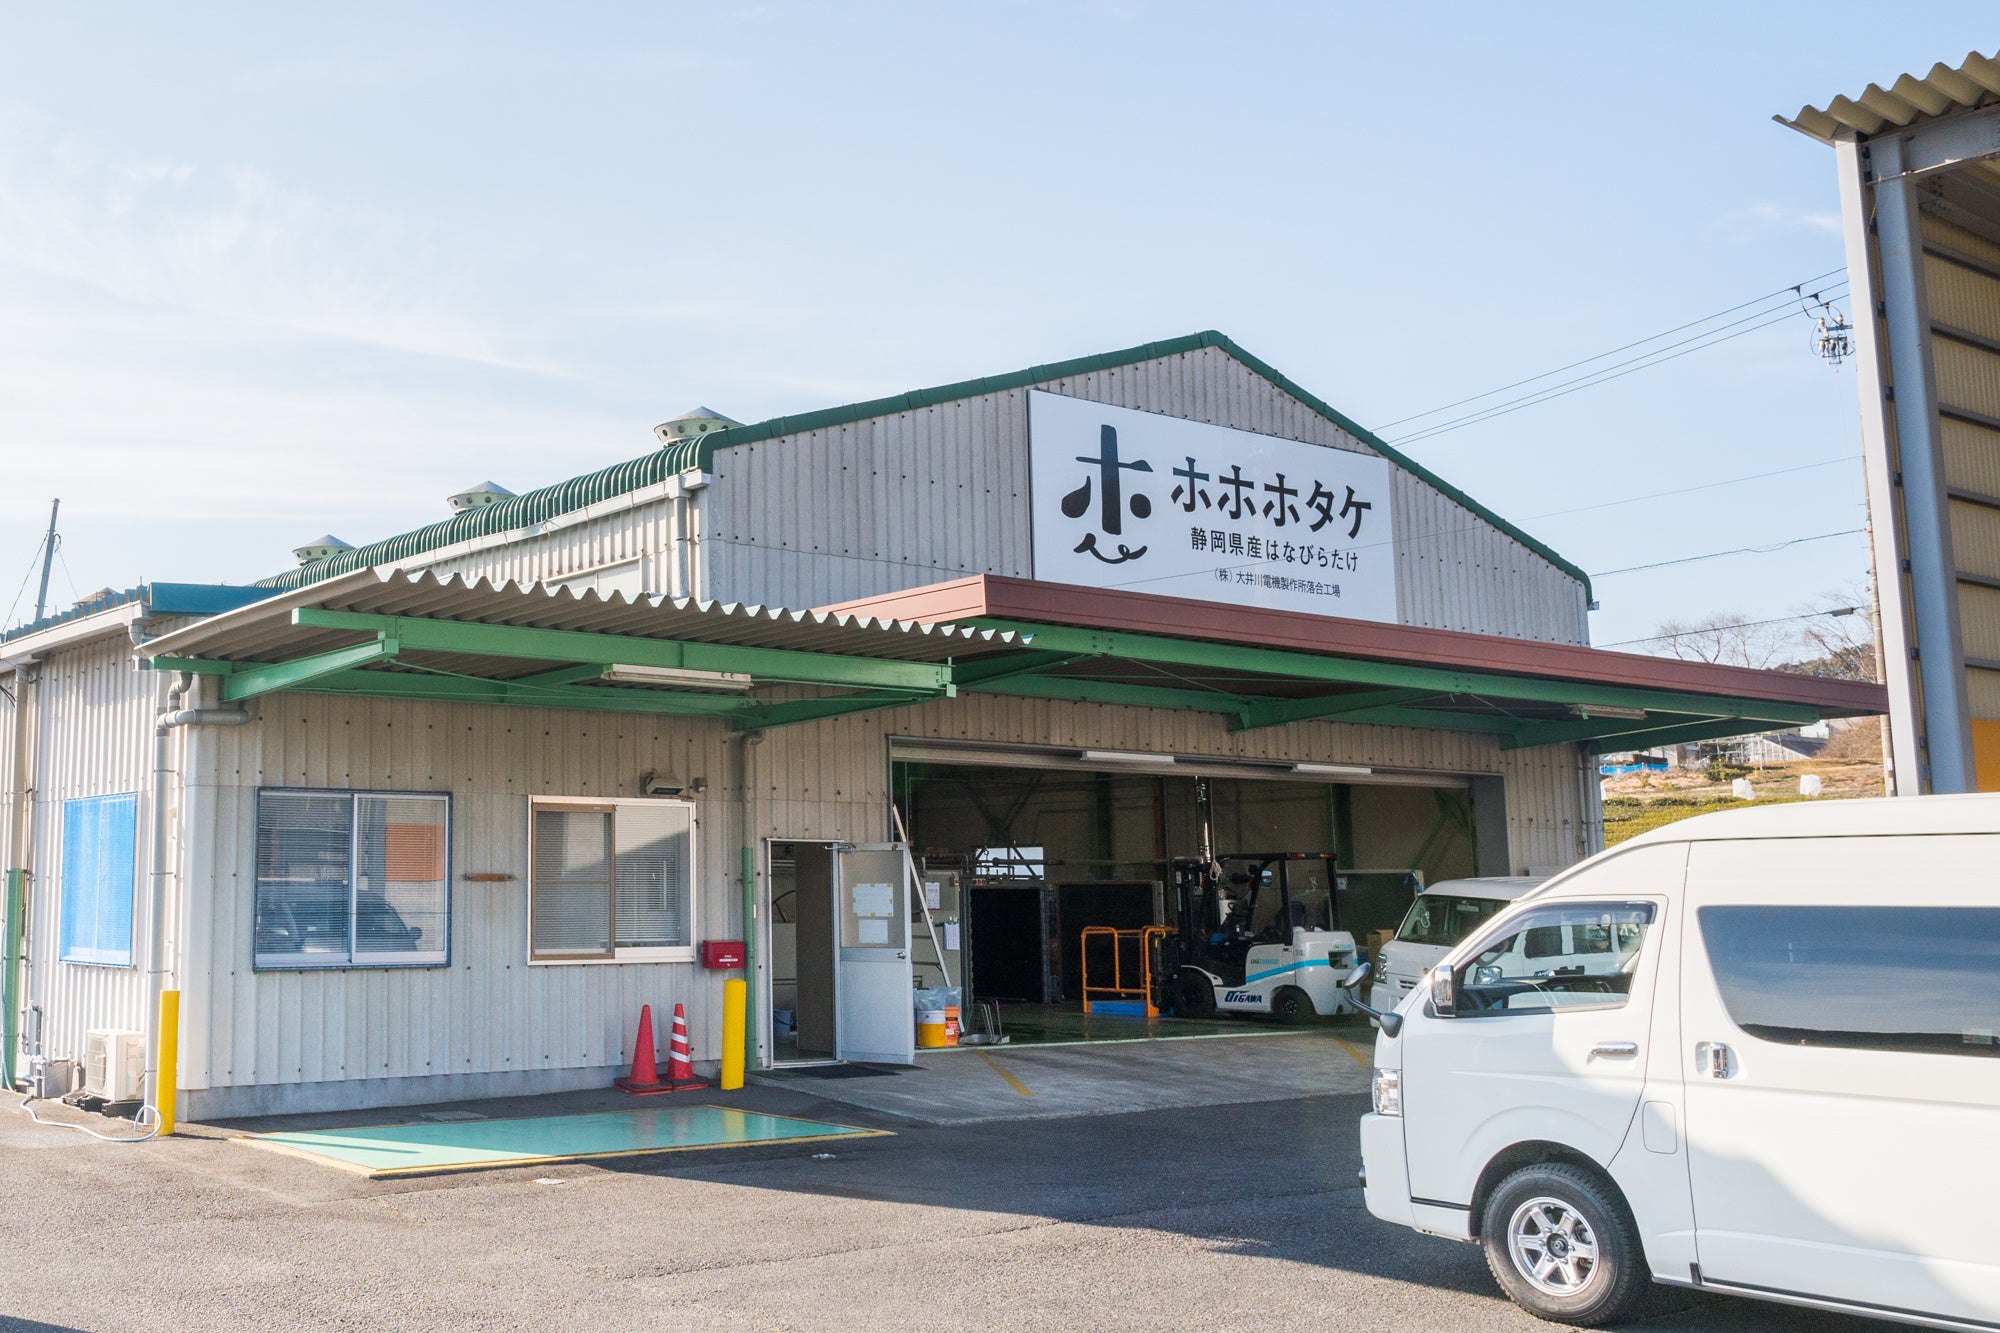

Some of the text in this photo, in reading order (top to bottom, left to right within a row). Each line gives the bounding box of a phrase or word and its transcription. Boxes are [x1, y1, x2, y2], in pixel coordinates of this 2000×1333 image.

[1171, 456, 1372, 539] ホホホタケ
[1190, 527, 1358, 572] 静岡県産はなびらたけ
